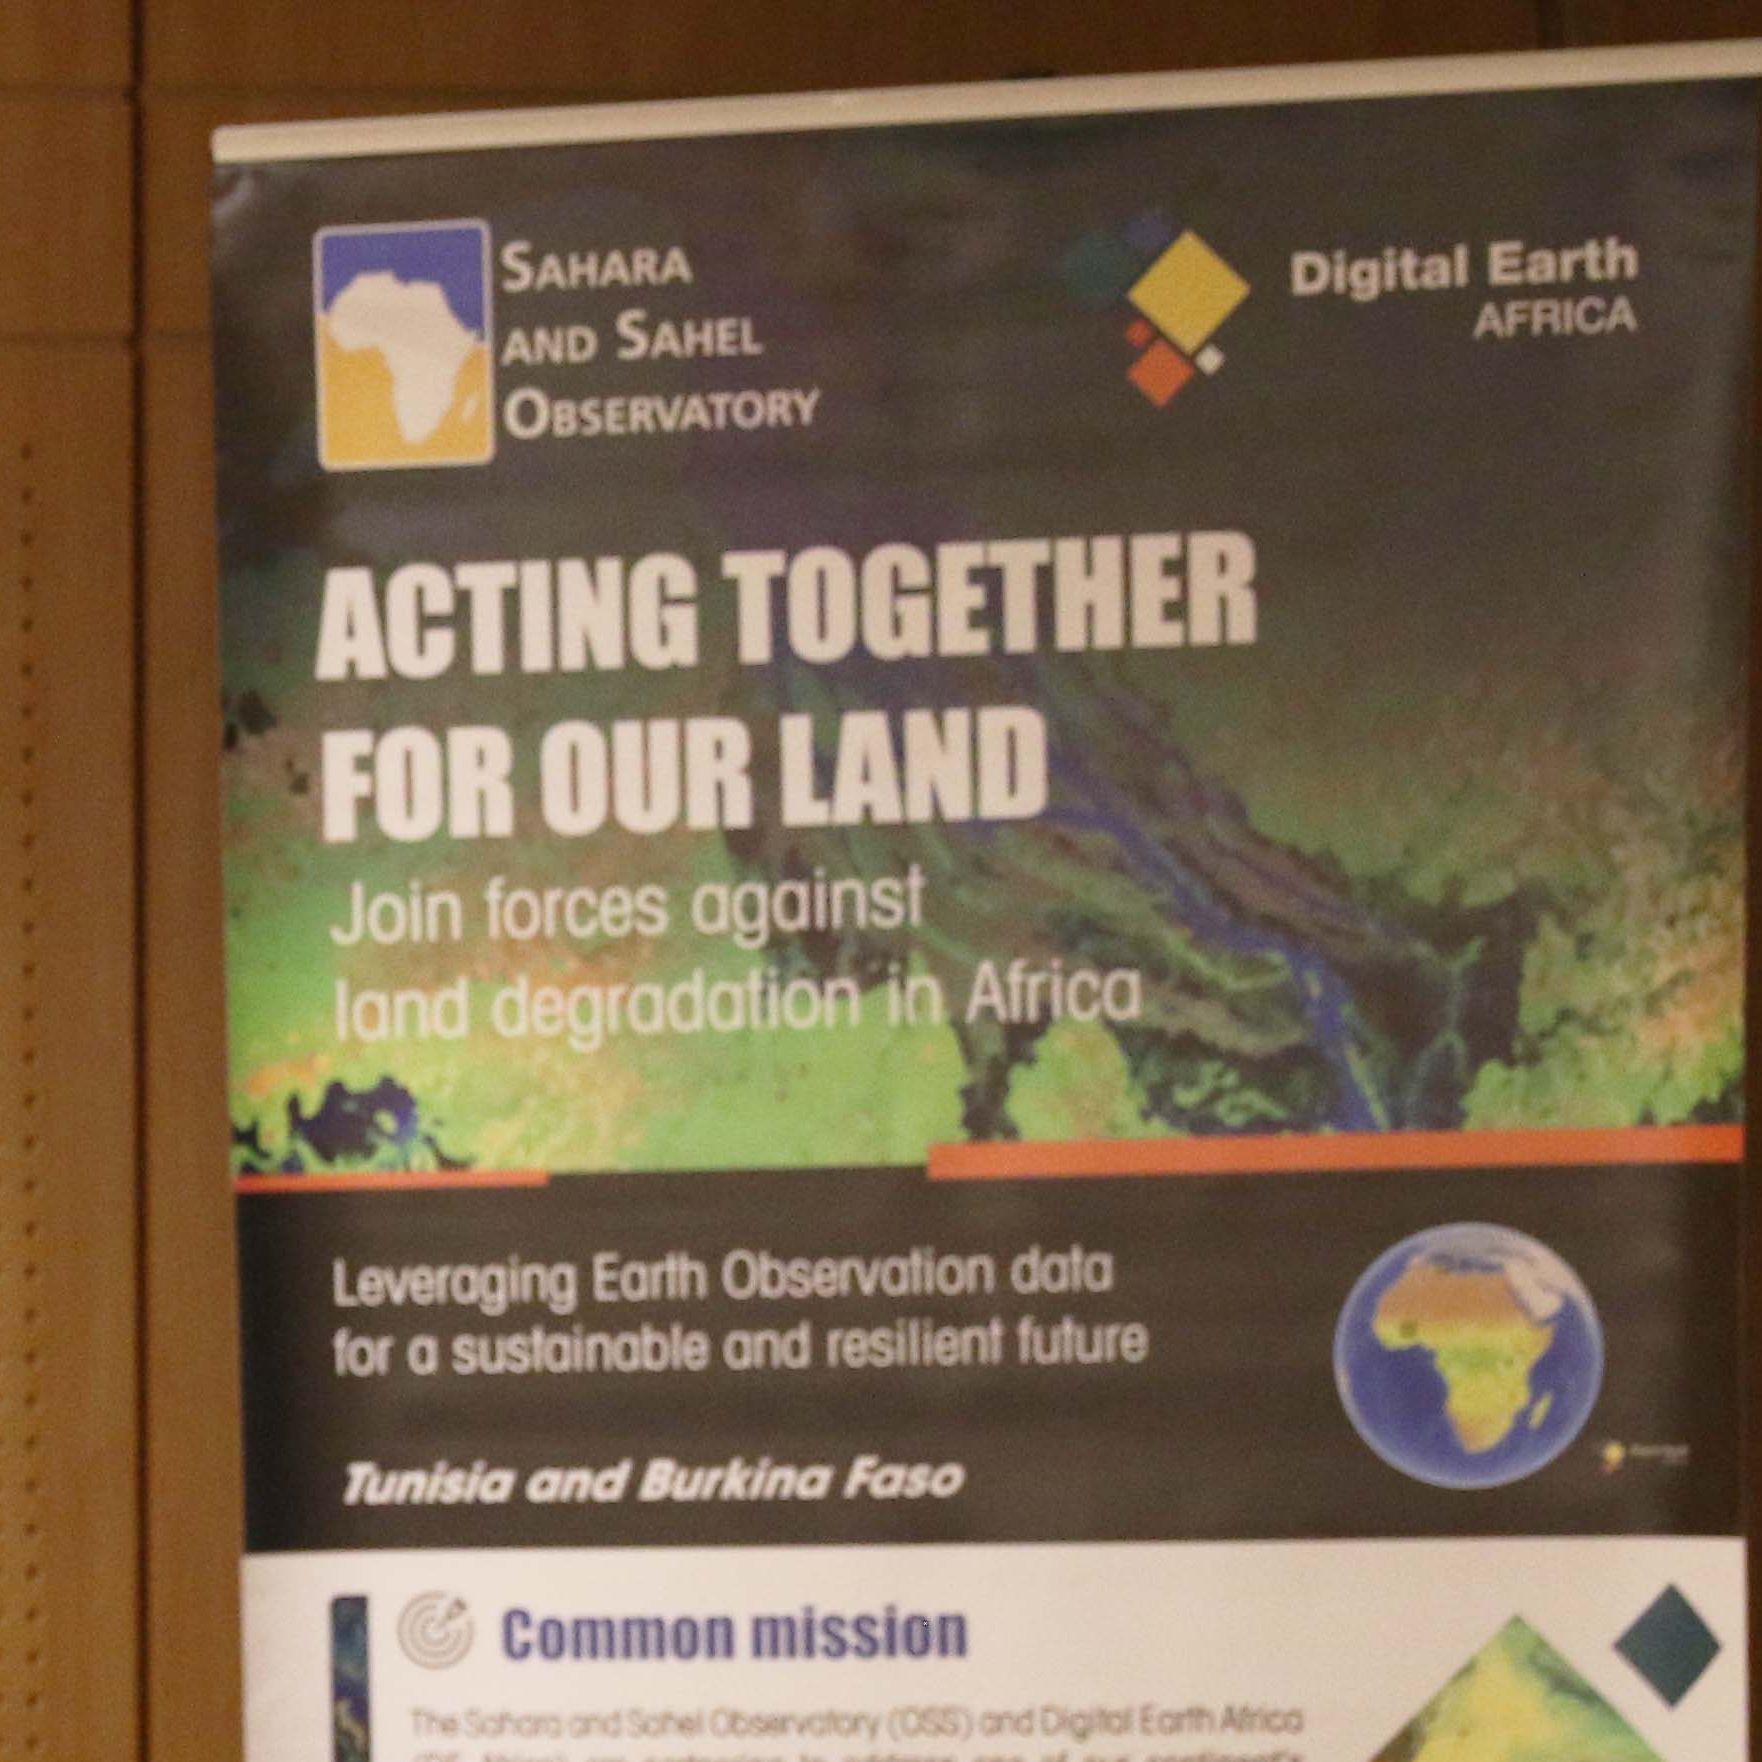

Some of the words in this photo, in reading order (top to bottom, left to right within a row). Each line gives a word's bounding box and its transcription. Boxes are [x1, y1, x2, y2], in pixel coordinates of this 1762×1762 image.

[1290, 245, 1469, 303] Digital
[1487, 236, 1639, 286] Earth
[1473, 294, 1637, 337] AFRICA
[317, 556, 697, 679] ACTING
[725, 535, 1254, 660] TOGETHER
[323, 726, 514, 842] FOR
[541, 719, 751, 836] OUR
[782, 708, 1046, 824] LAND
[329, 881, 465, 948] Join
[484, 876, 669, 940] forces
[691, 865, 925, 950] against
[334, 977, 470, 1041] land
[493, 969, 862, 1051] degradation
[887, 971, 942, 1027] in
[965, 958, 1143, 1023] Africa
[334, 1259, 579, 1316] Leveraging
[592, 1251, 709, 1302] Earth
[721, 1248, 996, 1299] Observation
[1009, 1246, 1115, 1294] data
[333, 1329, 394, 1375] for
[406, 1334, 440, 1376] a
[452, 1324, 710, 1374] sustainable
[722, 1320, 812, 1370] and
[826, 1317, 1004, 1367] resilient
[1016, 1316, 1149, 1364] future
[345, 1461, 516, 1504] Tunisia
[525, 1459, 633, 1503] and
[639, 1458, 834, 1501] Burkina
[843, 1454, 966, 1498] Faso
[502, 1608, 736, 1660] Common
[751, 1606, 968, 1659] mission
